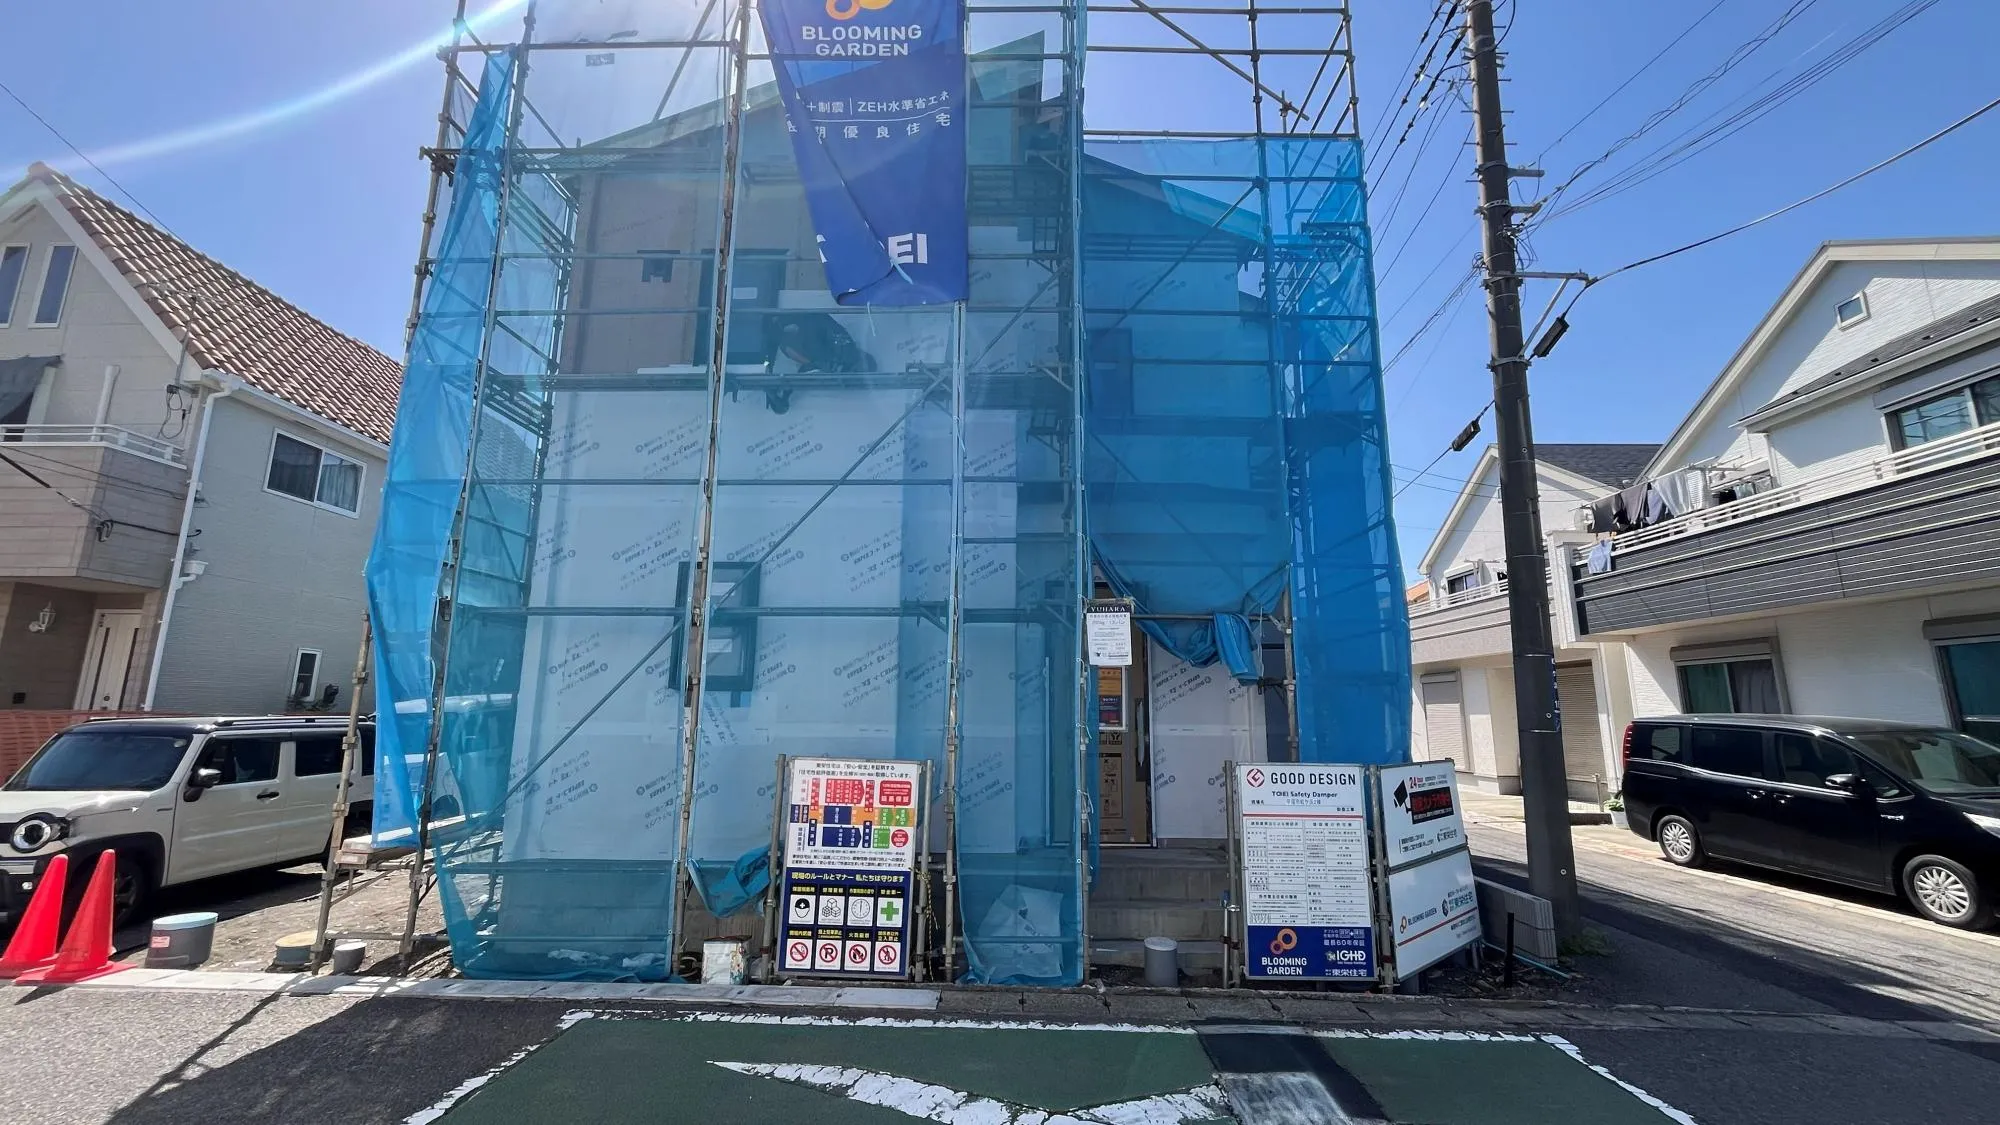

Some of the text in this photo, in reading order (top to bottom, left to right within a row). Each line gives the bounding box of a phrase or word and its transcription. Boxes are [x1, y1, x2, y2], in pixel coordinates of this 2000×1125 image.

[802, 24, 923, 41] BLOOMING
[815, 43, 909, 57] GARDEN
[1270, 772, 1356, 786] GOOD DESIGN
[856, 874, 904, 882] 私たちは守ります
[1336, 950, 1366, 961] IGHD
[1262, 957, 1308, 966] BLOOMING
[1267, 966, 1302, 976] GARDEN
